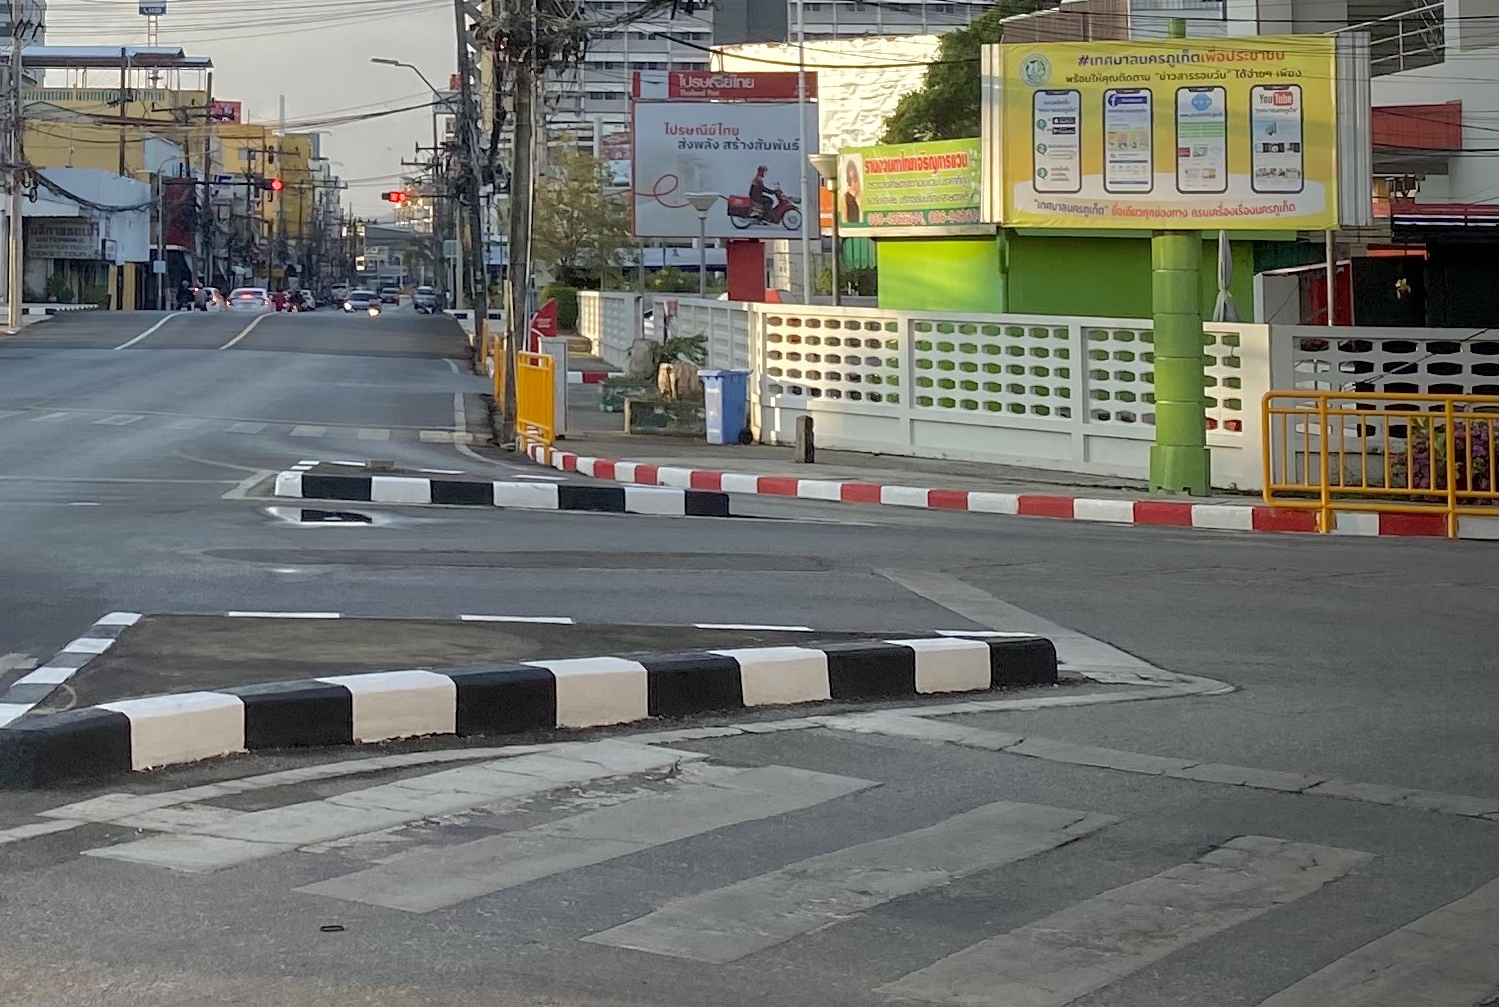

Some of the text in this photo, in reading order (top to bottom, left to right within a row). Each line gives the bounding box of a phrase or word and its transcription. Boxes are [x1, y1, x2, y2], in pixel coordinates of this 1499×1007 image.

[664, 122, 740, 136] ไปรษณีย์ไทย
